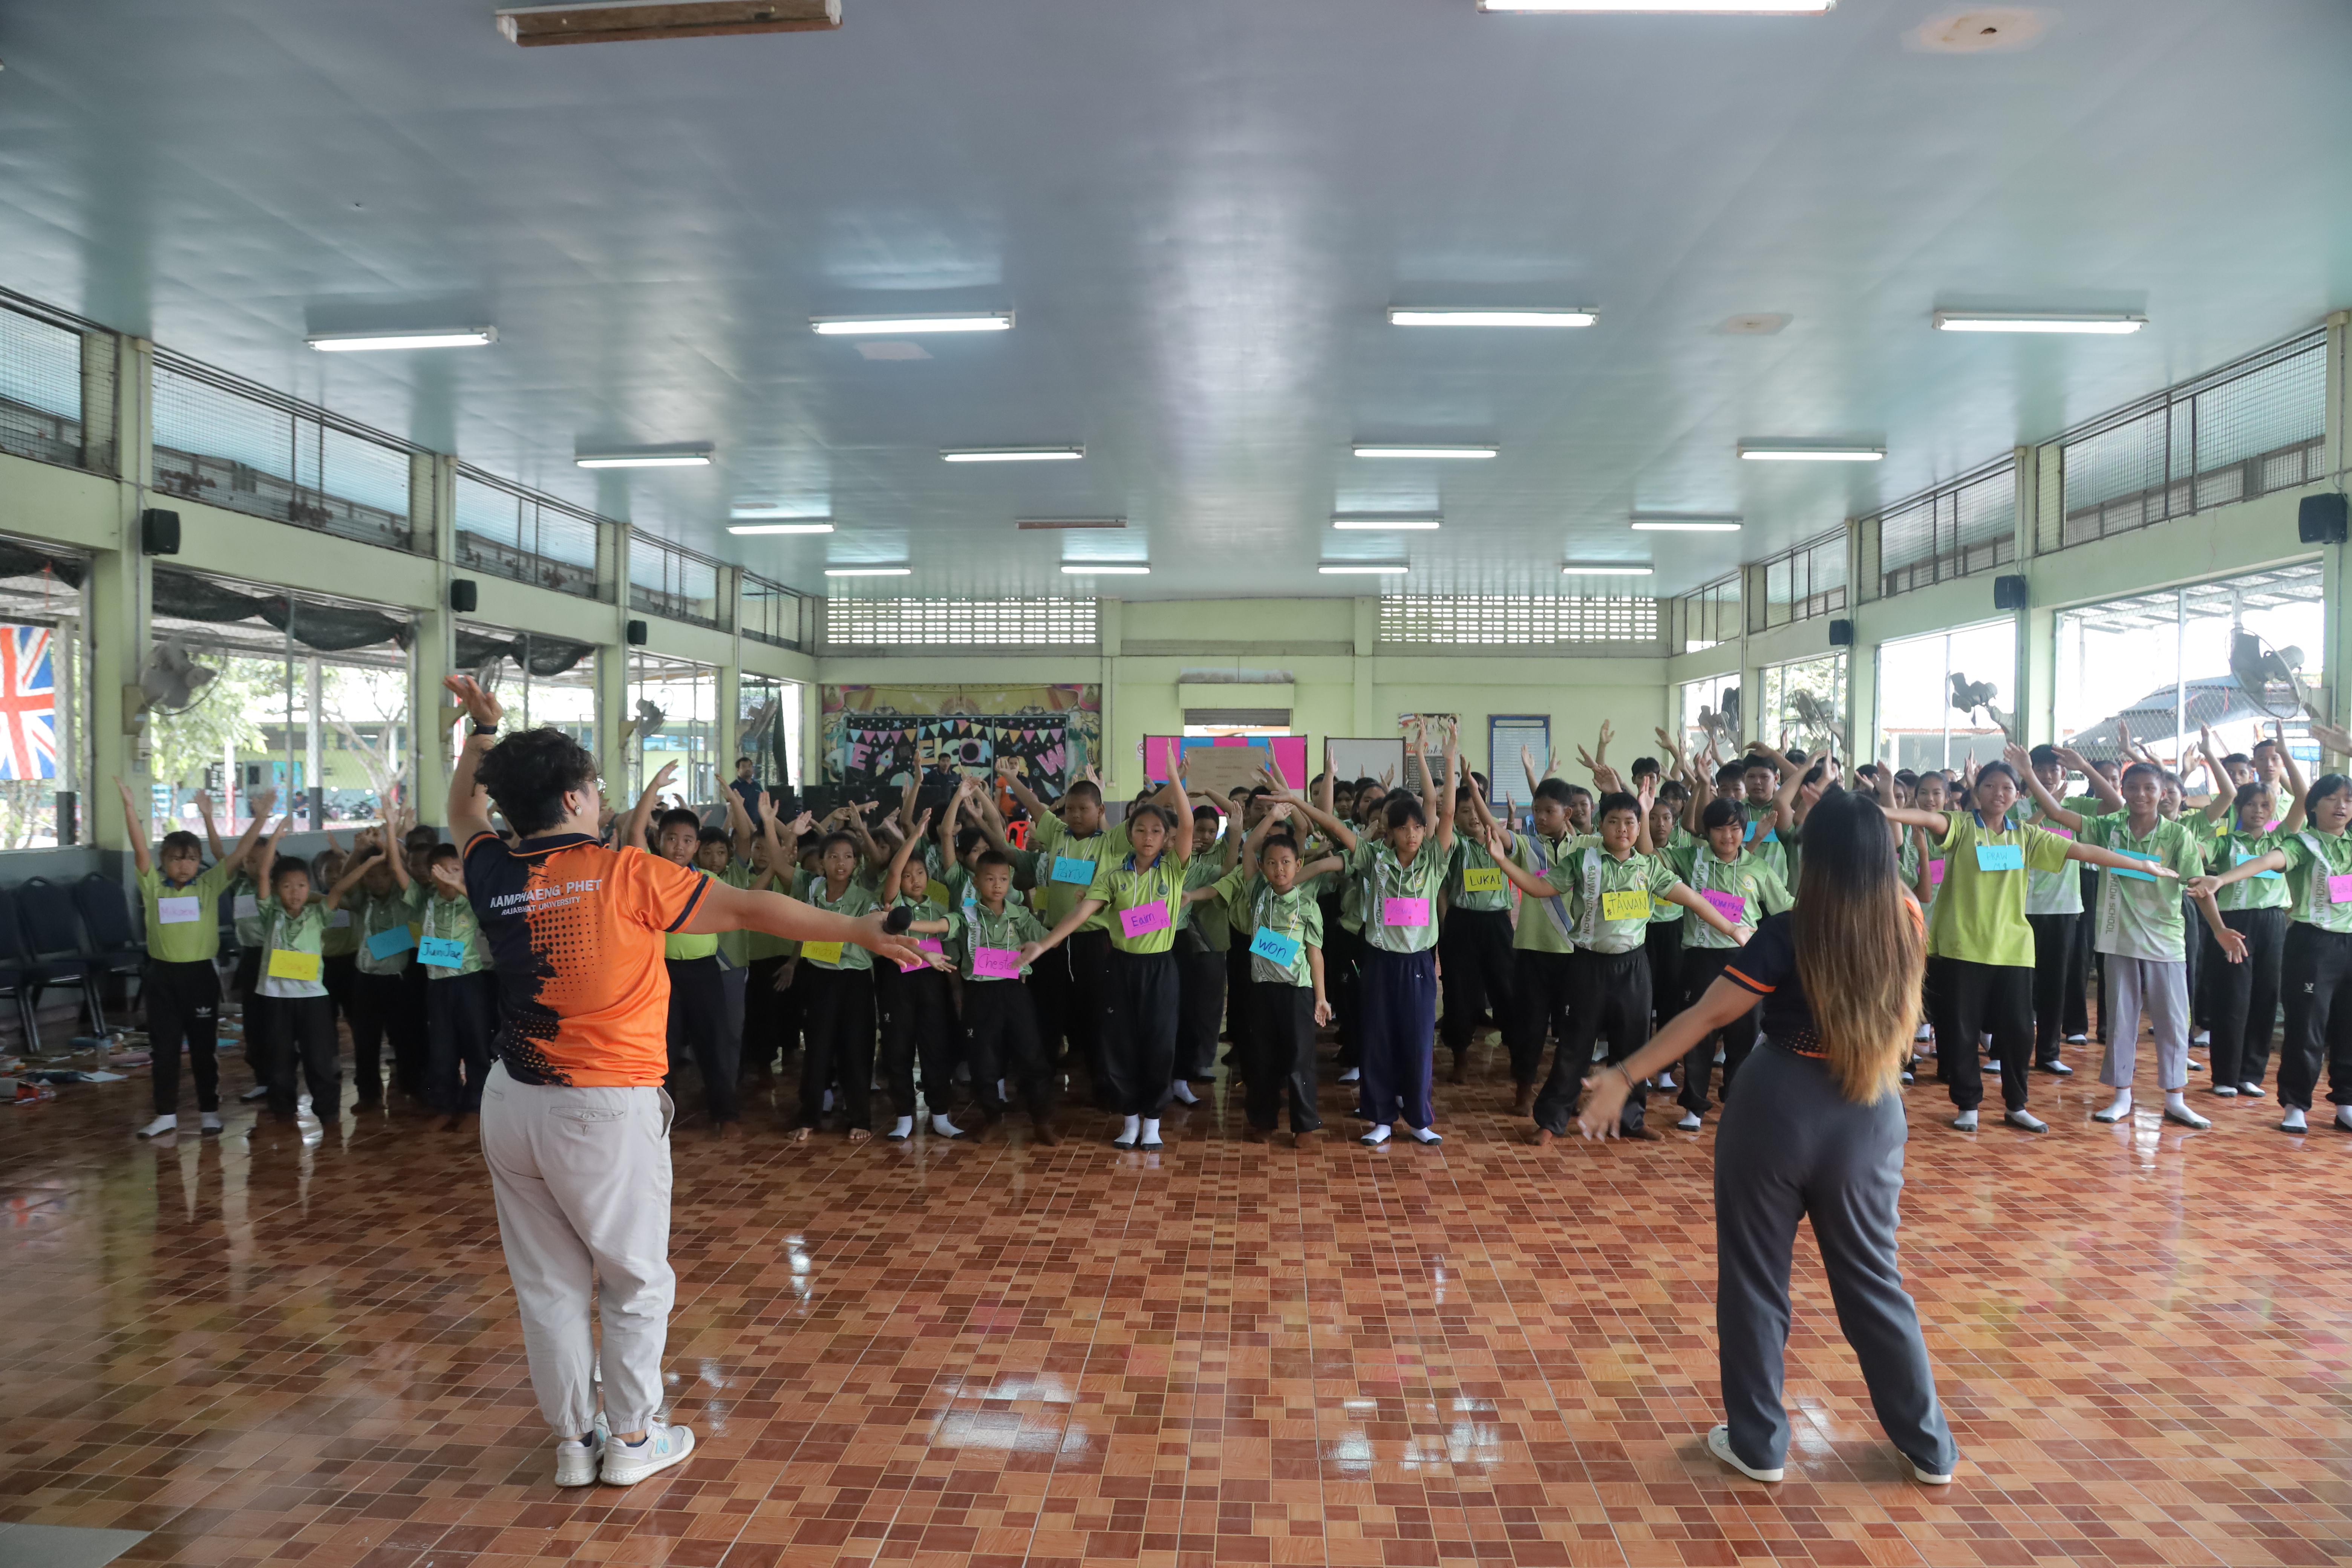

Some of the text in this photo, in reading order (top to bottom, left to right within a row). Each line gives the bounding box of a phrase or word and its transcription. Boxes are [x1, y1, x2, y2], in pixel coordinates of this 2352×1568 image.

[490, 879, 602, 908] KAMPHAENG PHET
[501, 896, 581, 915] RAJABHAT UNIVERSITY
[1608, 897, 1647, 915] TAWAN
[2105, 903, 2116, 934] SCHOOL
[978, 954, 1016, 970] Cheste
